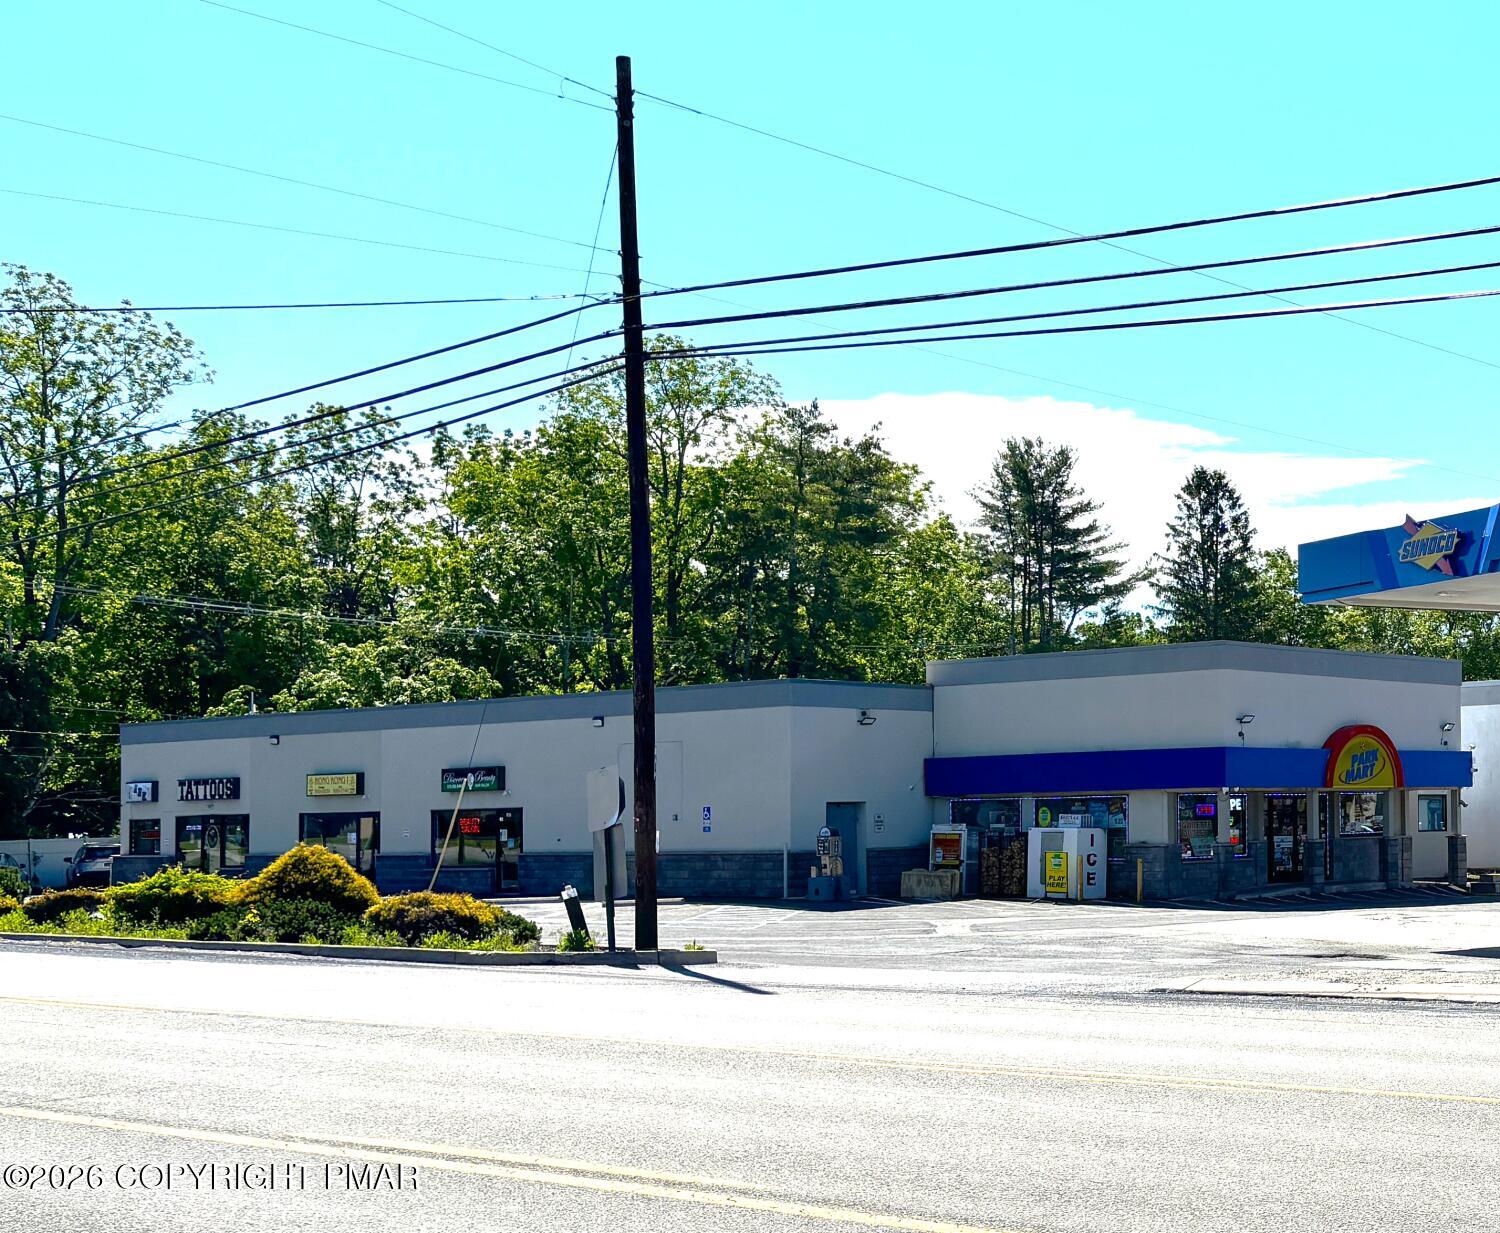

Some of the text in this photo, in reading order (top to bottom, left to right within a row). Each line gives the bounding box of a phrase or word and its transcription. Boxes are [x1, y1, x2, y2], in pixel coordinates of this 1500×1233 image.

[1400, 532, 1456, 560] SUNOCO
[1351, 748, 1379, 769] PARK
[1345, 763, 1376, 784] MART
[178, 779, 232, 800] TATTOOS
[1086, 833, 1098, 886] ICE
